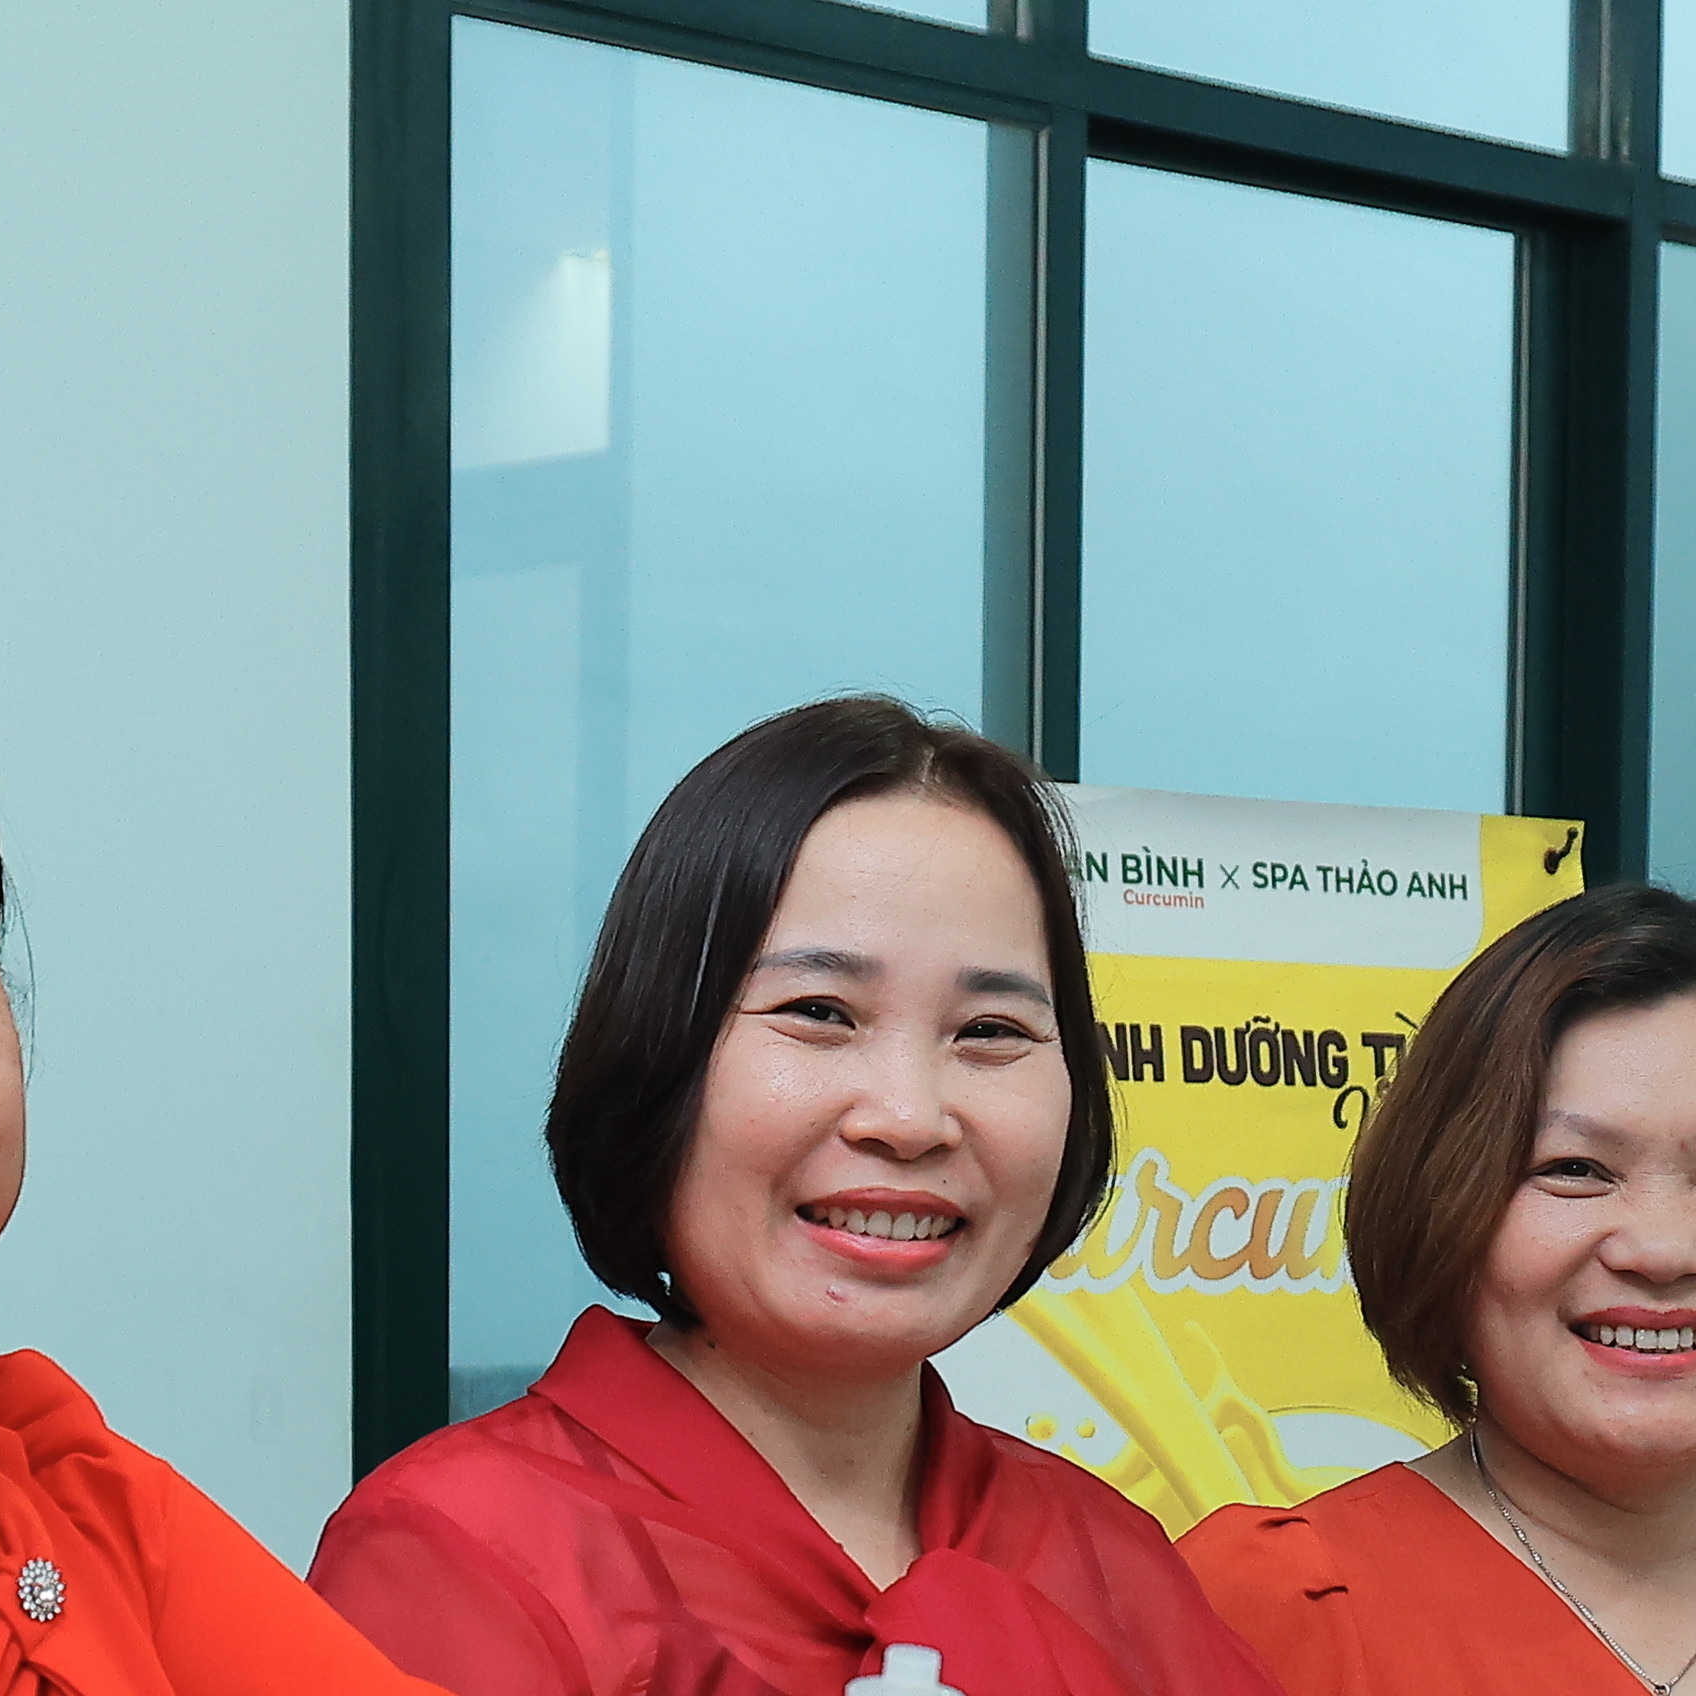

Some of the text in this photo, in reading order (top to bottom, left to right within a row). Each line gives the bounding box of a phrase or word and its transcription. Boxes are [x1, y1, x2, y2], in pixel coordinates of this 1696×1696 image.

[1121, 845, 1205, 888] BÌNH
[1252, 861, 1310, 892] SPA
[1316, 858, 1398, 897] THẢO
[1406, 871, 1468, 901] ANH
[1122, 888, 1205, 909] Curcumin
[1097, 1020, 1165, 1083] NH
[1180, 1014, 1350, 1089] DƯỠNG
[1046, 1154, 1341, 1284] urcu
